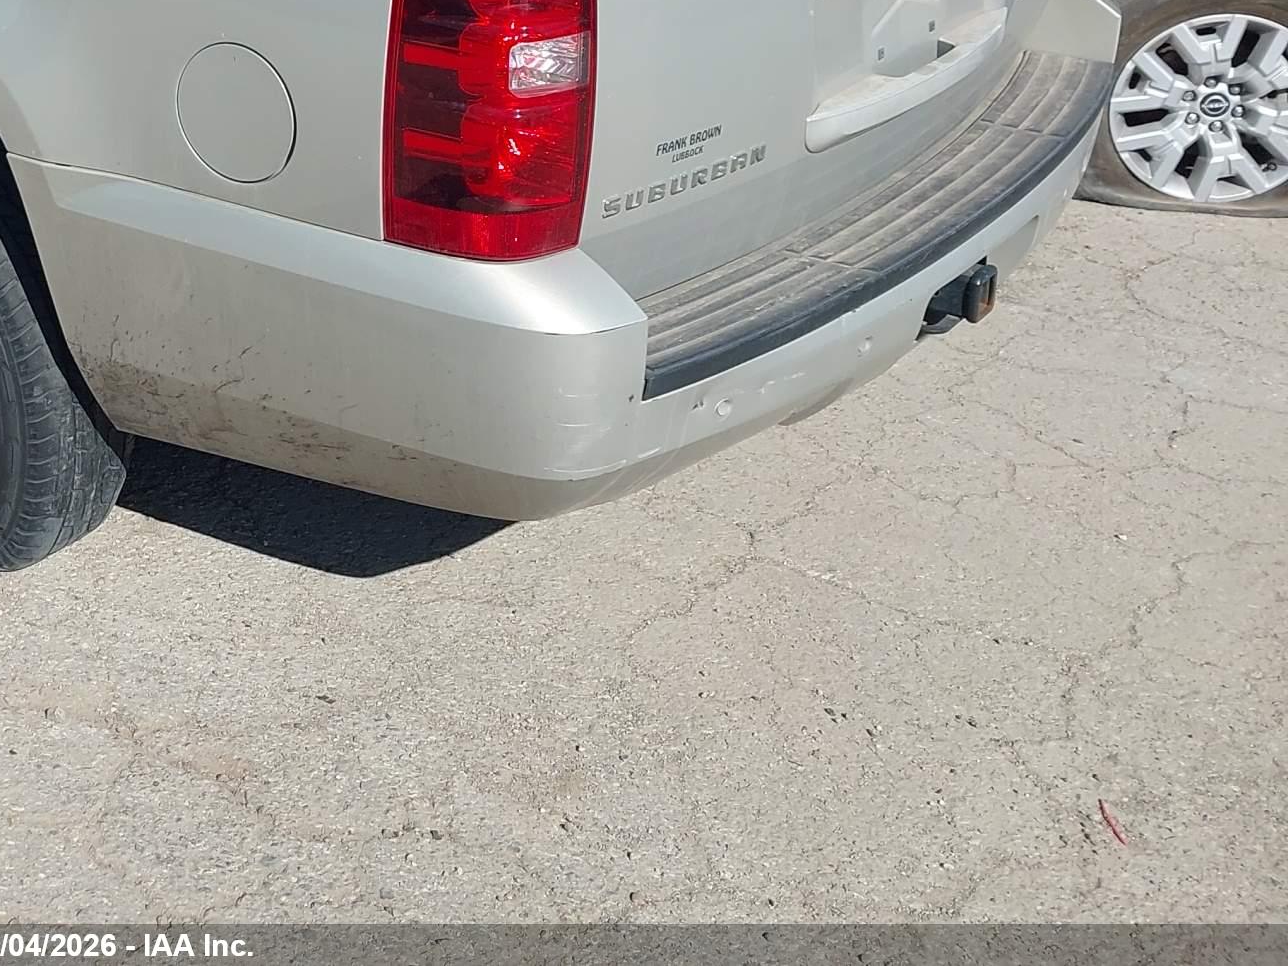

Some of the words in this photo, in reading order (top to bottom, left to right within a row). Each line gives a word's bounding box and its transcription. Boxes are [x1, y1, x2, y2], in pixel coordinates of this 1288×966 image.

[656, 136, 688, 157] FRANK
[689, 124, 722, 146] BROWN
[601, 144, 767, 219] SUBURBAN
